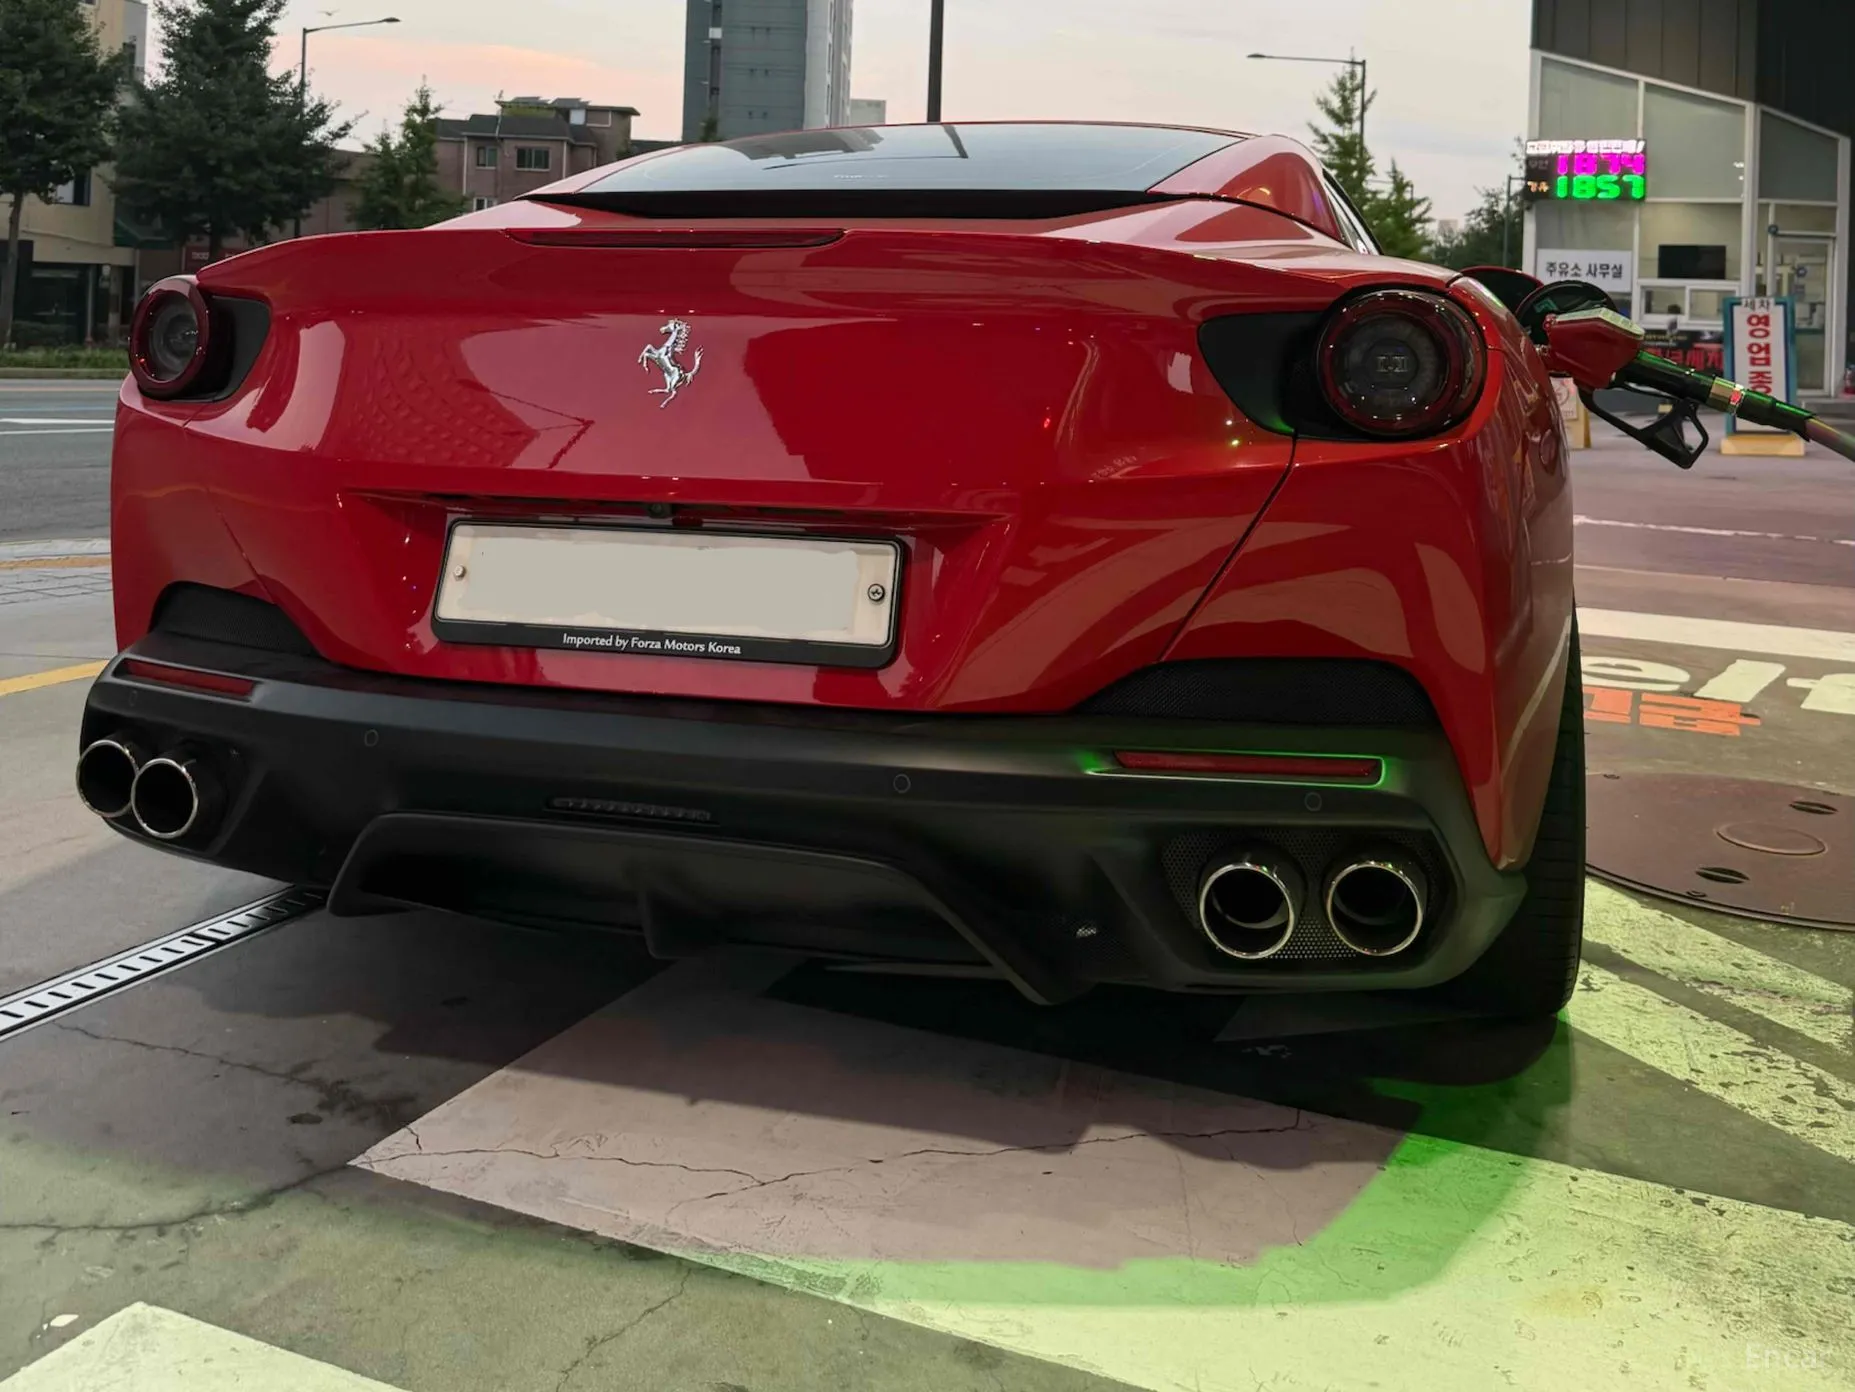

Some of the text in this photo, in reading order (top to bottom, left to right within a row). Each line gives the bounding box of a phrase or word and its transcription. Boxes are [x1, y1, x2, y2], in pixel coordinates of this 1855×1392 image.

[1557, 153, 1645, 175] 1874
[1557, 174, 1645, 199] 1857
[1545, 261, 1623, 279] 주유소 사무실
[1743, 299, 1771, 312] 세차
[1747, 314, 1772, 395] 영업중
[562, 633, 742, 655] Imported by Forza Motors Korea
